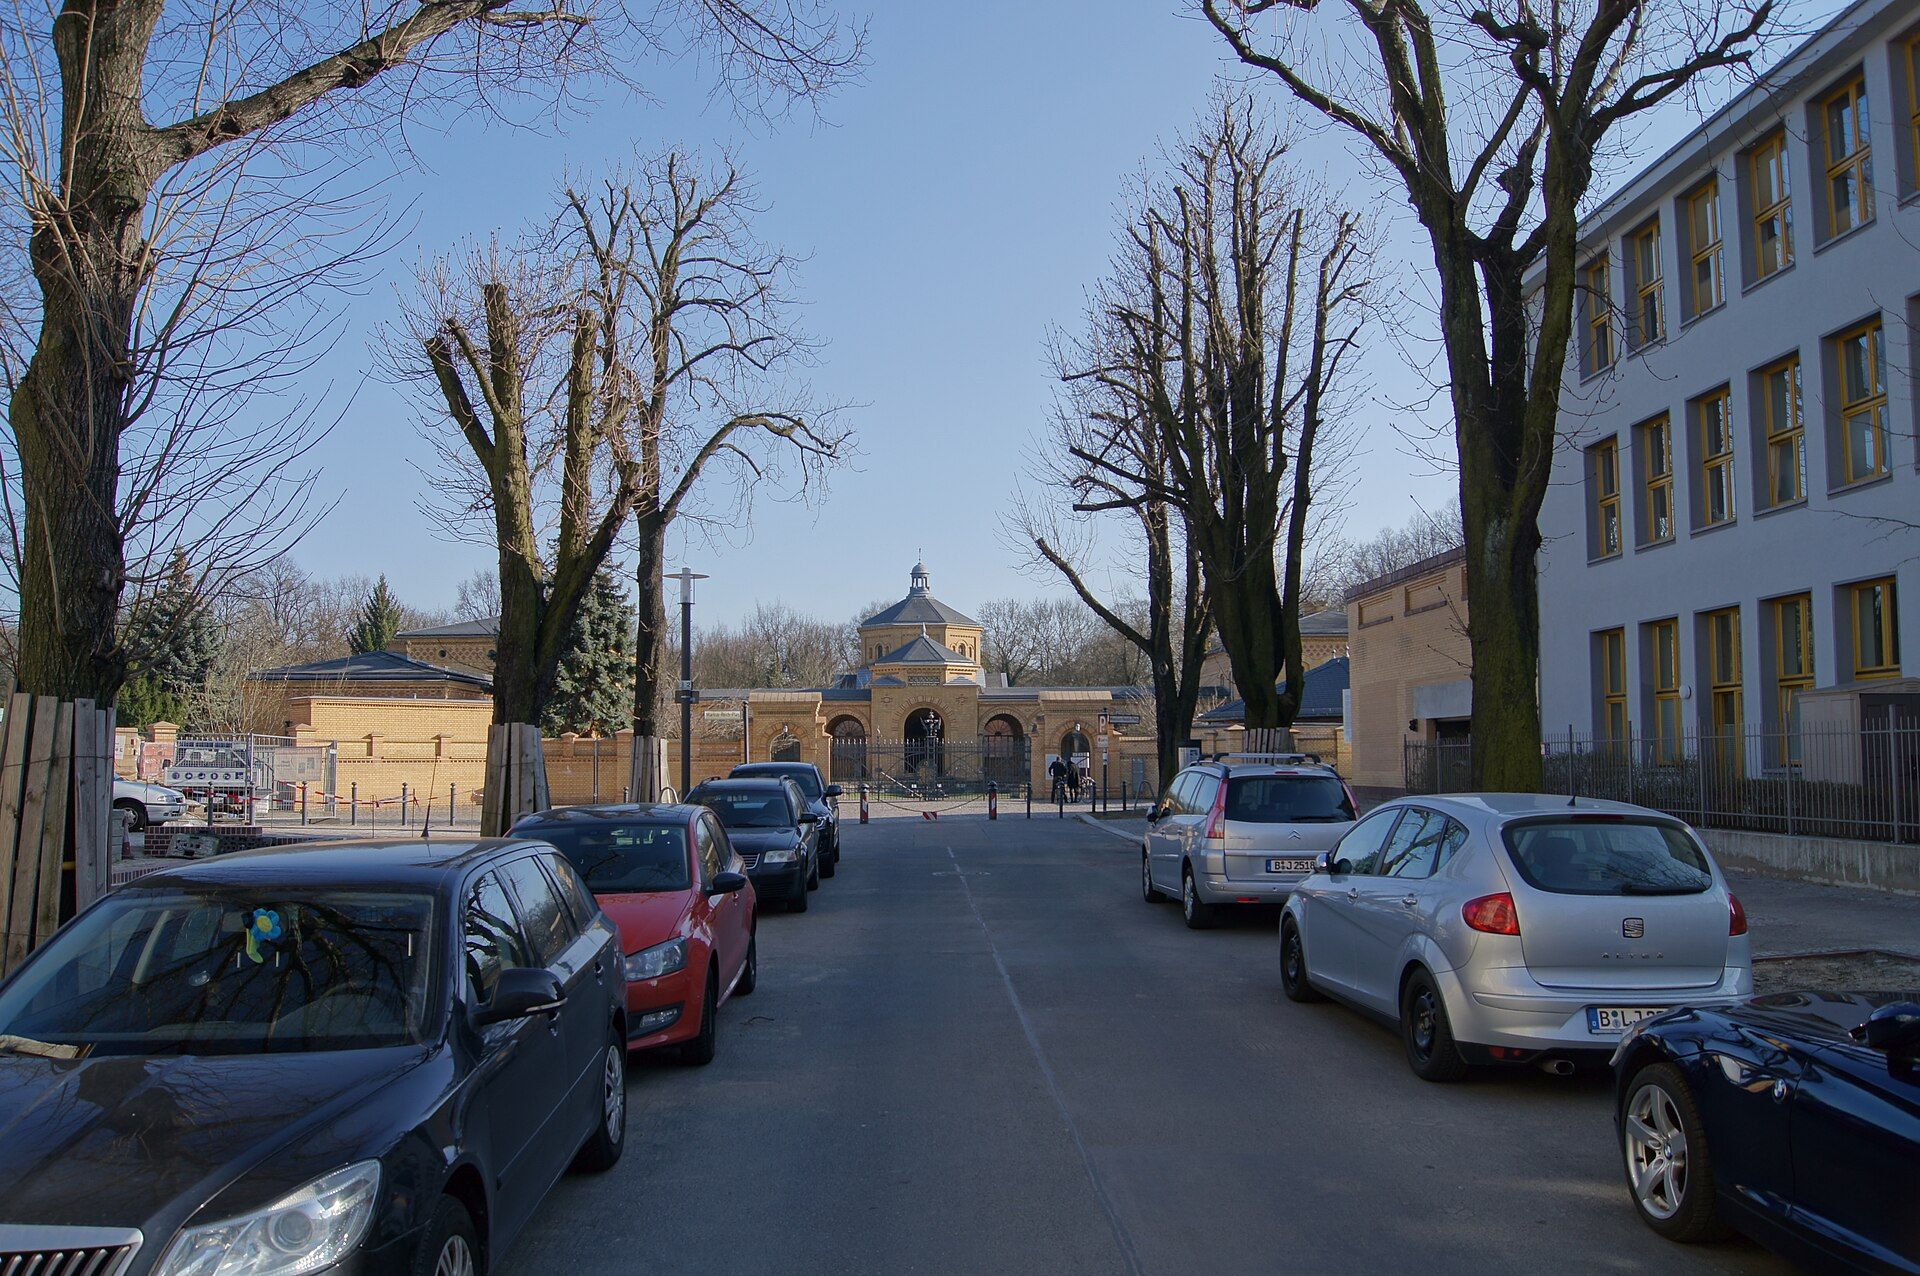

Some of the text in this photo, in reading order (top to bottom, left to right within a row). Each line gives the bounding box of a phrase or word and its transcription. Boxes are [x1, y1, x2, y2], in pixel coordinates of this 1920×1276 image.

[1274, 861, 1281, 870] B
[1286, 861, 1293, 870] J
[1600, 1010, 1611, 1027] B
